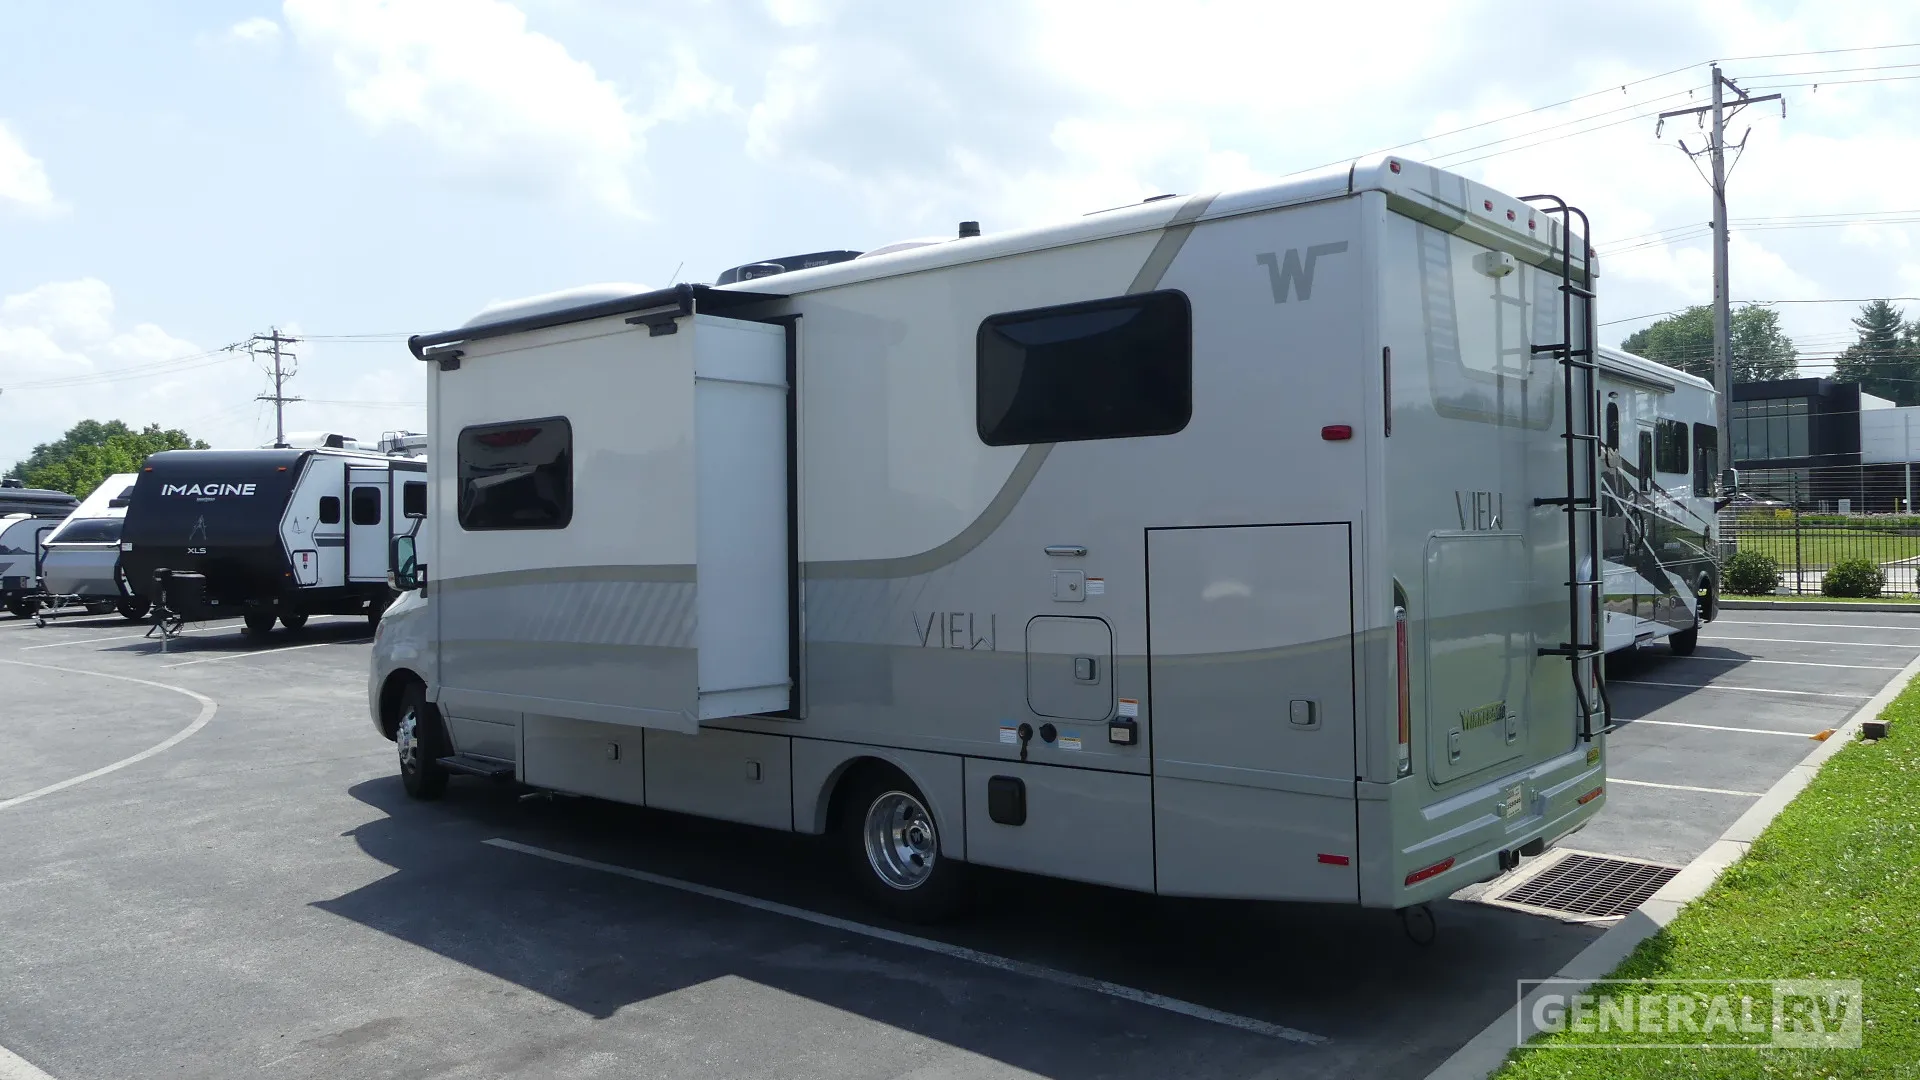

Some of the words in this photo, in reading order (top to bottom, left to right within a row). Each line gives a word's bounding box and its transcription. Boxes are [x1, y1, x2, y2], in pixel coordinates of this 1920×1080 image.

[161, 483, 257, 496] IMAGINE
[1455, 490, 1503, 531] VIEW
[912, 611, 996, 651] VIEW
